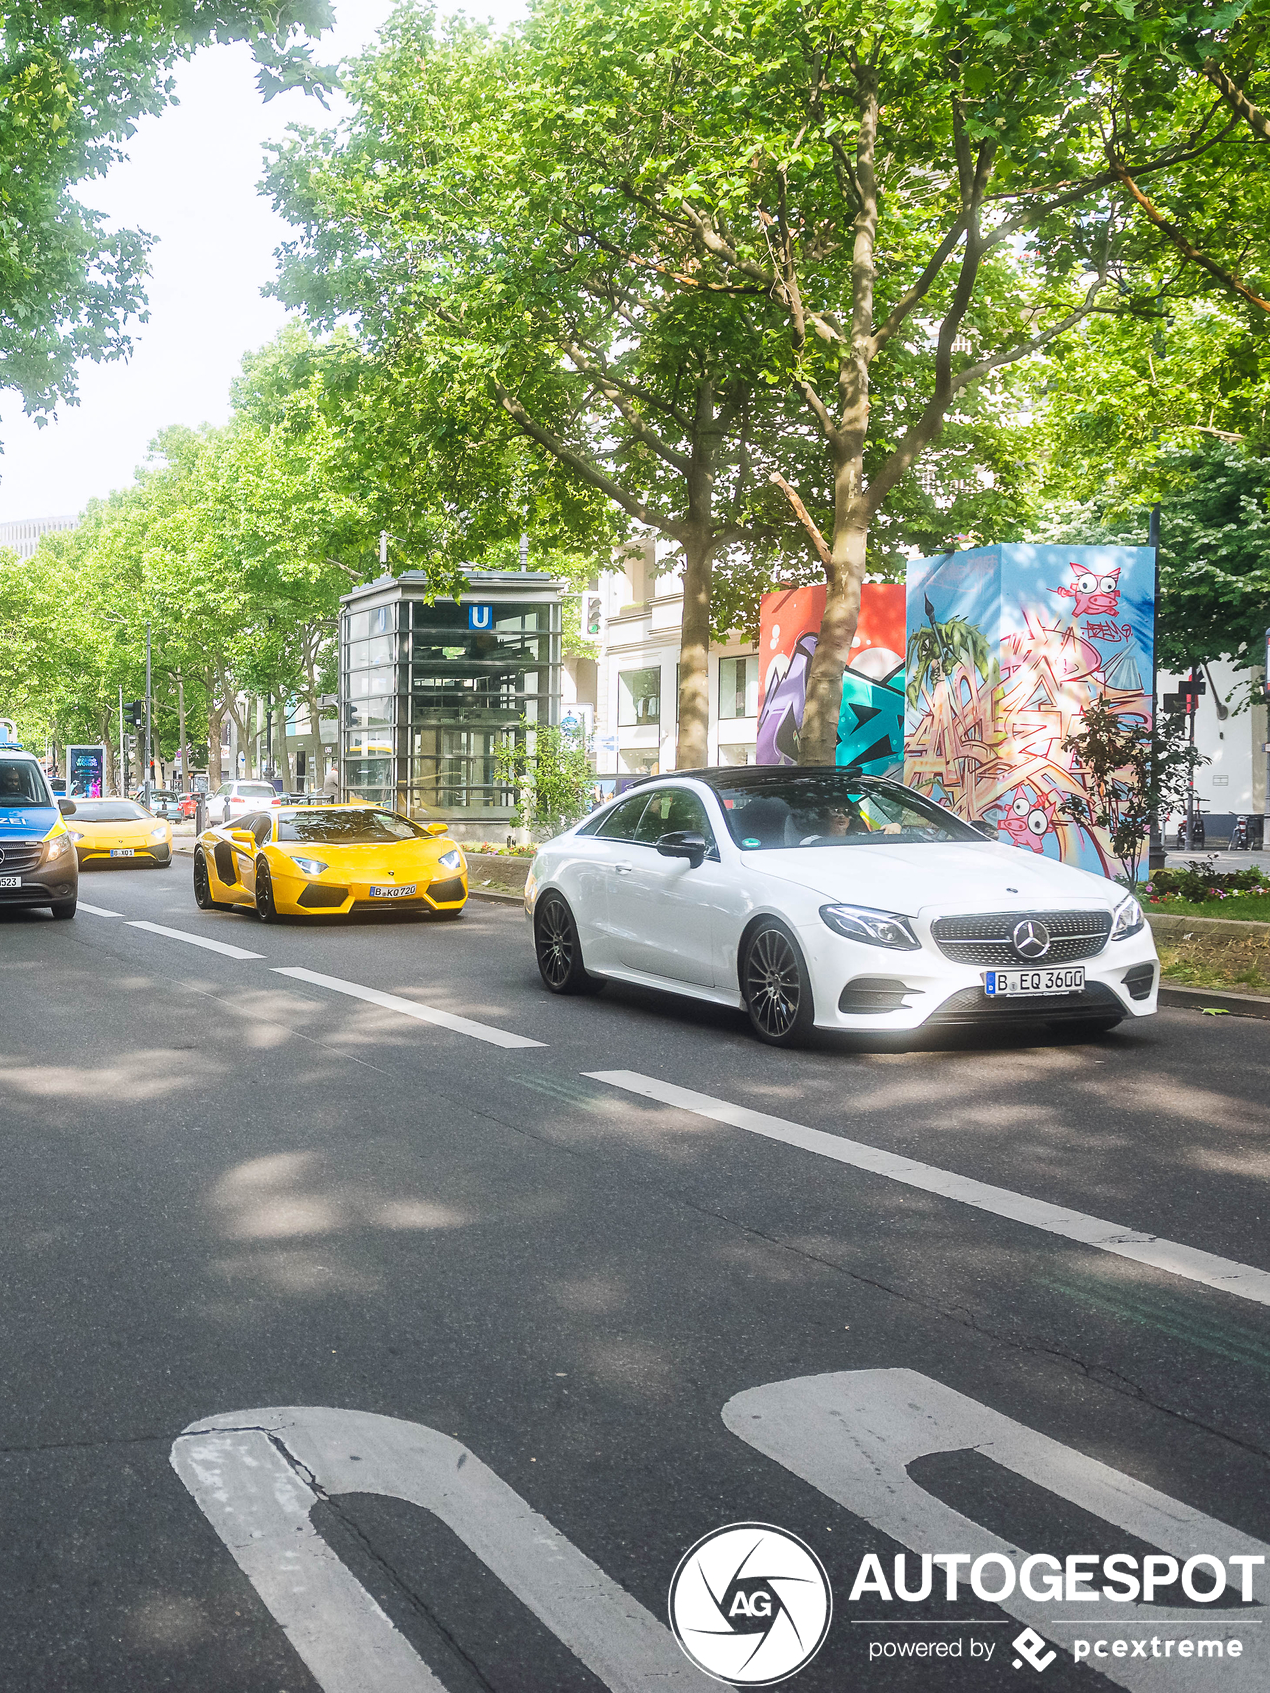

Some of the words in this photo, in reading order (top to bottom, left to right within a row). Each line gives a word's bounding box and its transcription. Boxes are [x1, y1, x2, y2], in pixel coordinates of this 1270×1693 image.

[472, 606, 489, 628] U
[375, 888, 381, 896] B
[400, 886, 416, 896] 720
[998, 974, 1008, 991] B
[1020, 973, 1041, 990] EQ
[1045, 970, 1083, 989] 3600
